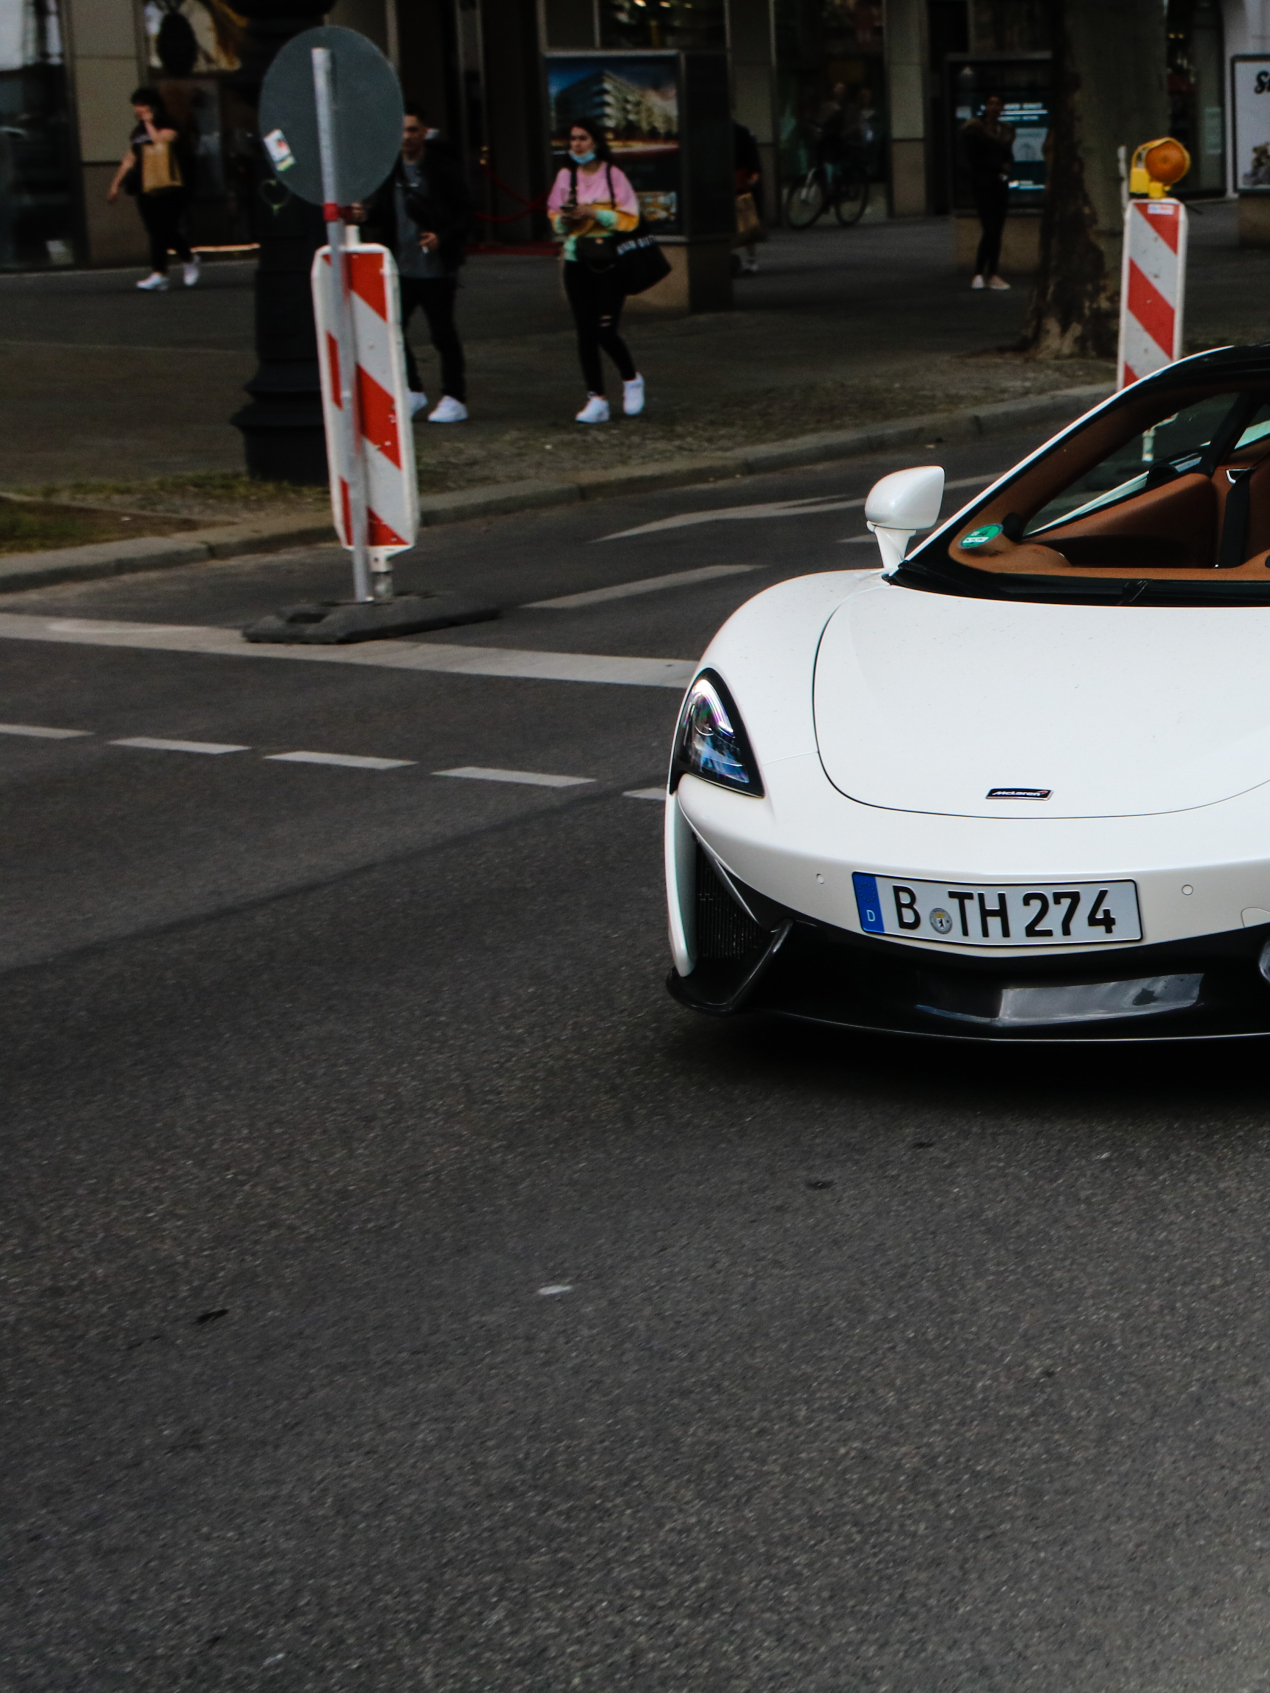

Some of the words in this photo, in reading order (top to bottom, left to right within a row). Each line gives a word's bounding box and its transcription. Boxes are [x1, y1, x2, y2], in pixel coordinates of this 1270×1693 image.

[866, 909, 876, 922] D
[892, 885, 921, 930] B
[948, 890, 1011, 938] TH
[1022, 889, 1116, 938] 274
